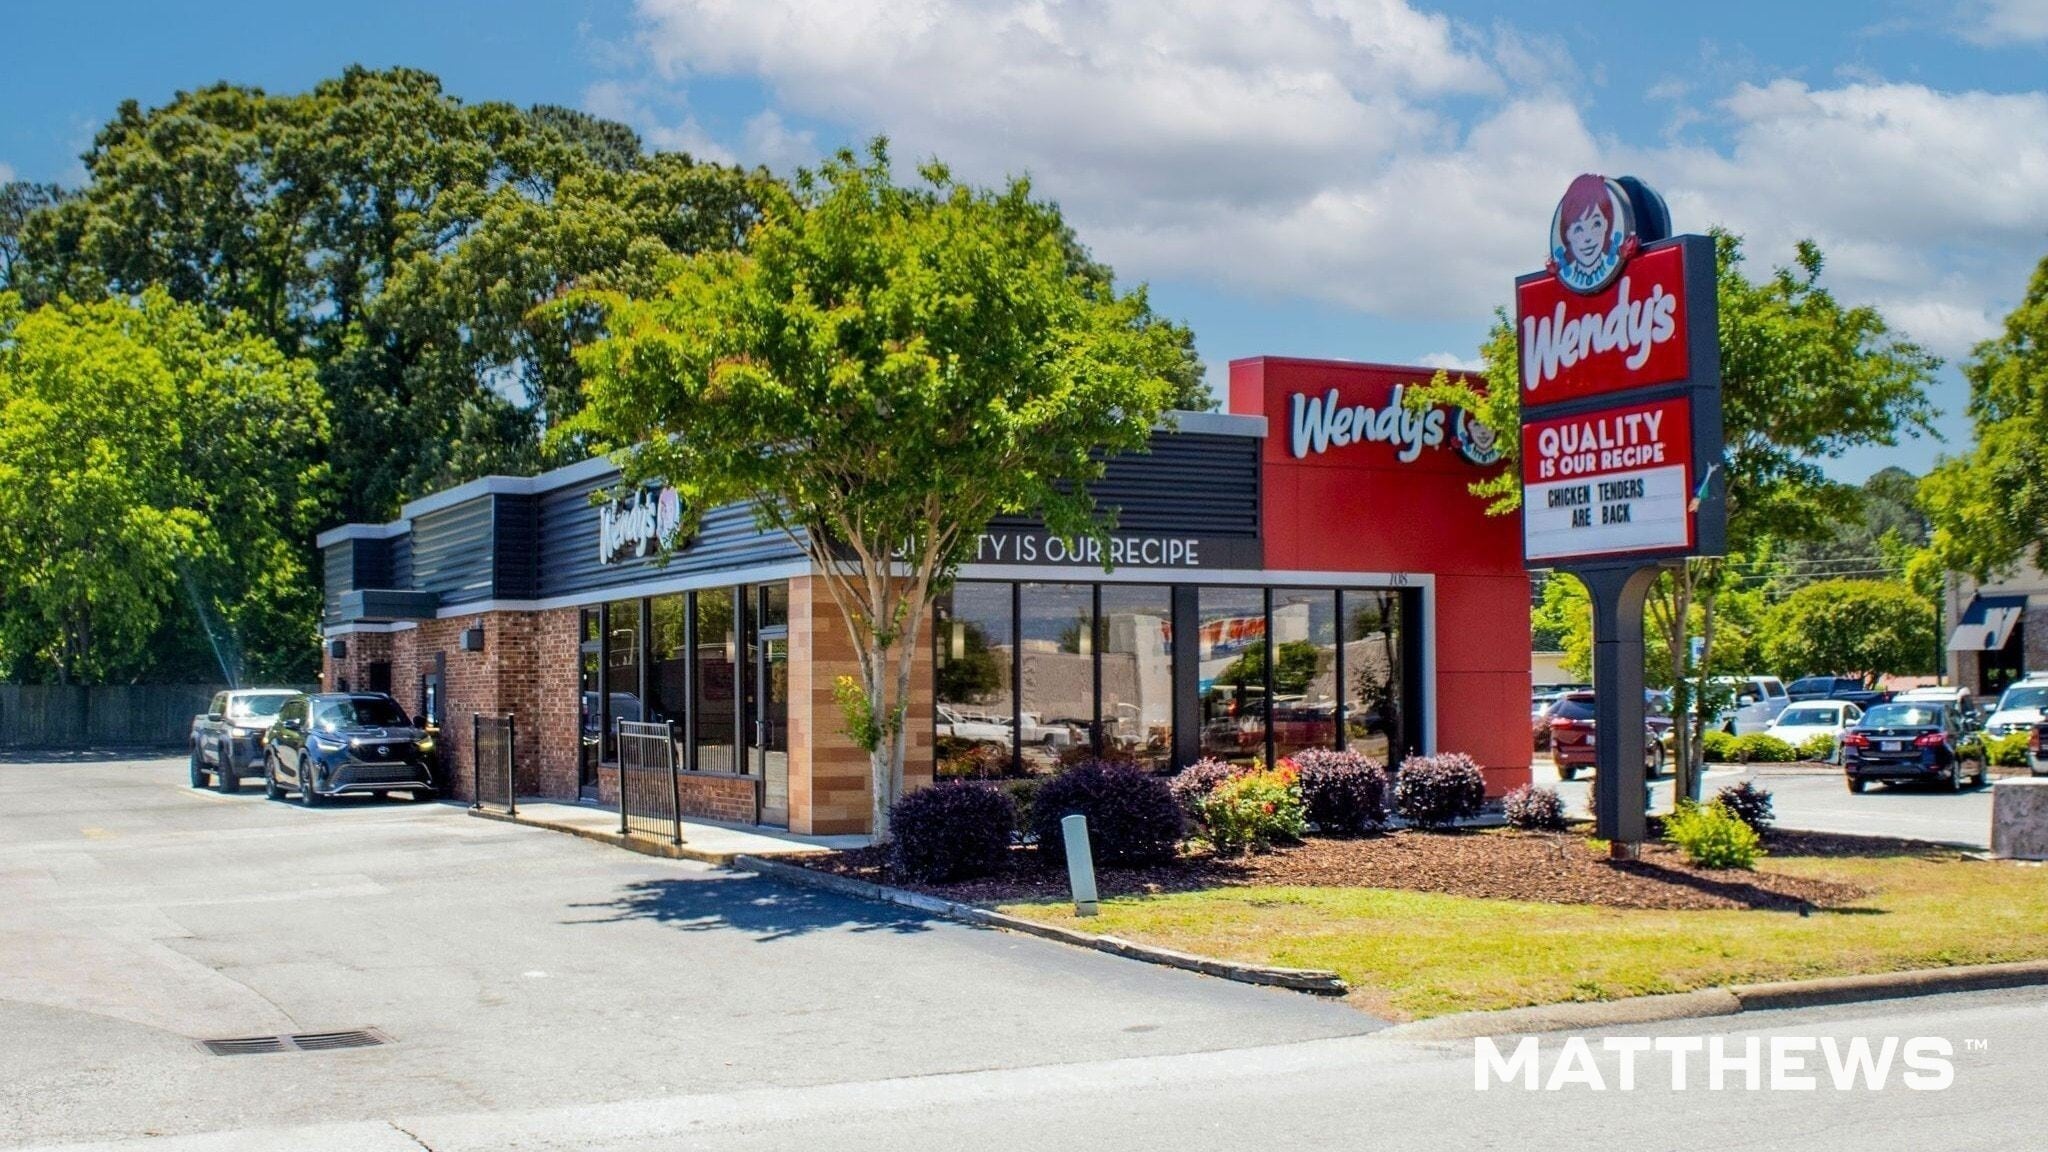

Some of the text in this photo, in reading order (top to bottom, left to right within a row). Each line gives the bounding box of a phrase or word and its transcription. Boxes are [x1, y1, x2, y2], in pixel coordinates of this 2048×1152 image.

[1523, 277, 1676, 391] Wendy's
[1539, 410, 1663, 459] QUALITY
[1540, 443, 1664, 478] IS OUR RECIPE
[1548, 478, 1645, 508] CHICKEN TENDERS
[1572, 503, 1631, 529] ARE BACK
[1016, 535, 1037, 561] IS
[1045, 536, 1101, 562] OUR
[1110, 537, 1200, 565] RECIPE
